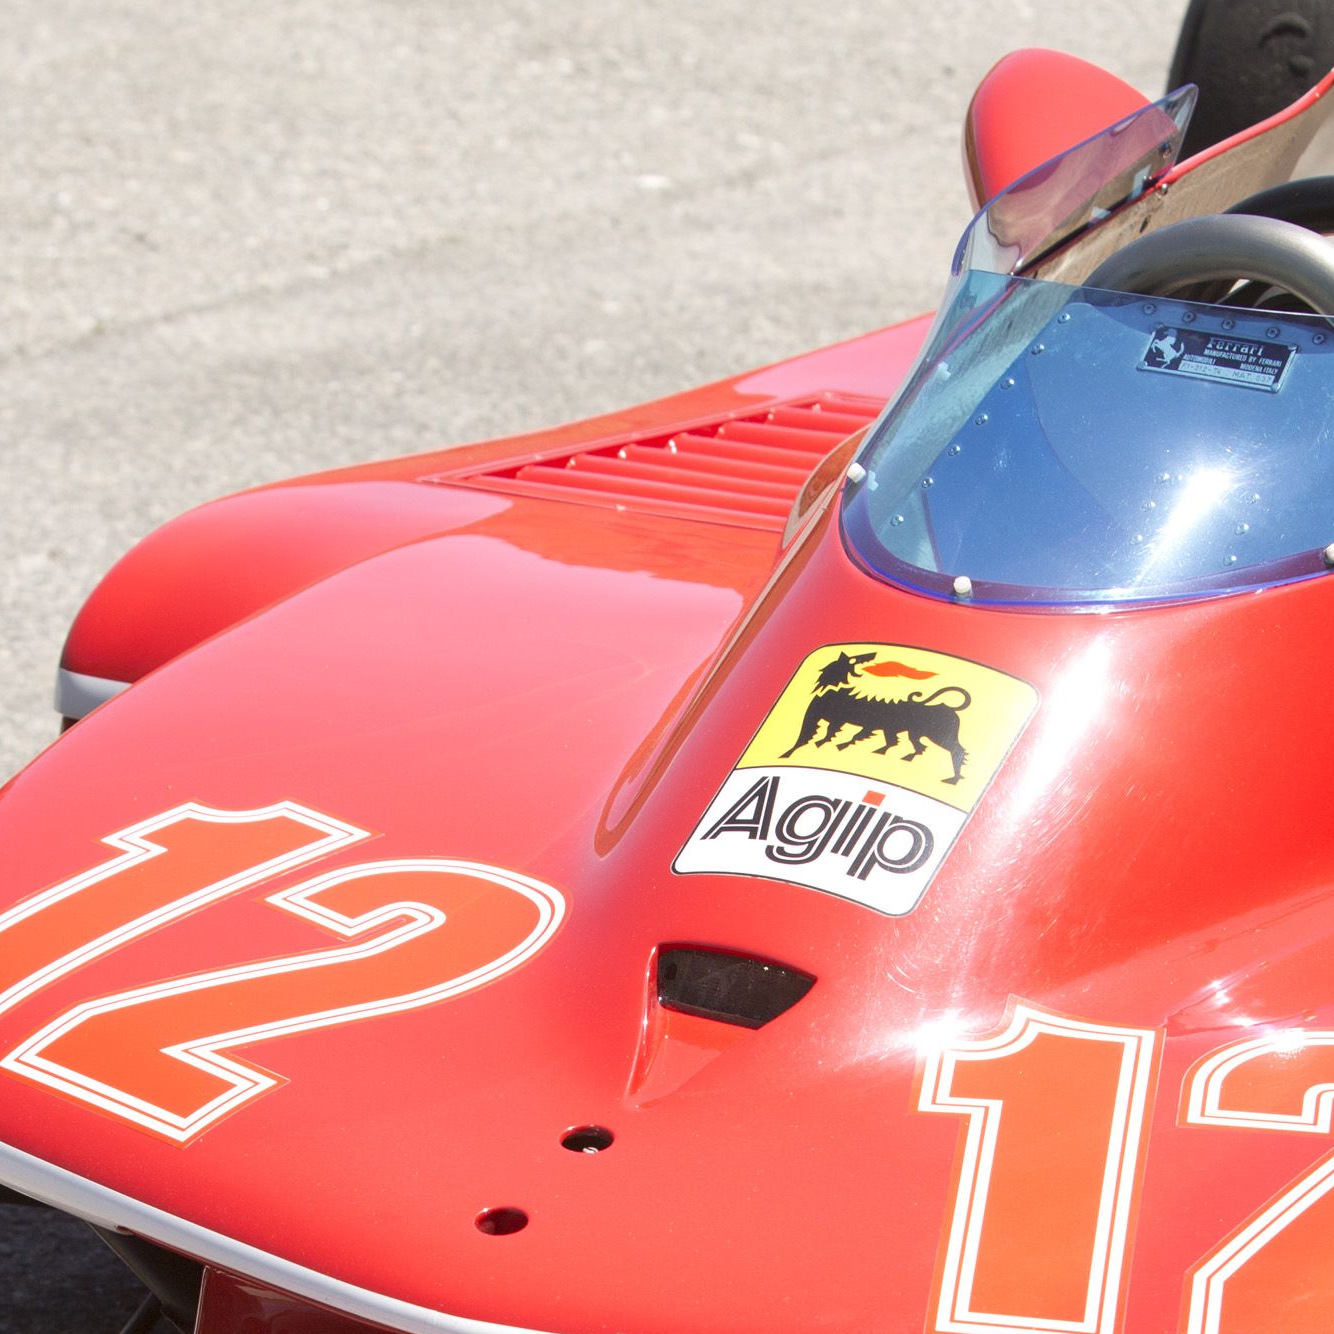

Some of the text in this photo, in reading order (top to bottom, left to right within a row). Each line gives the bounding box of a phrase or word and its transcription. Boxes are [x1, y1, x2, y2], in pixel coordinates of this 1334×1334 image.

[1207, 337, 1264, 356] Ferrari
[1203, 348, 1282, 368] MANUFACTURED BY FERRARI
[700, 776, 935, 881] Agip
